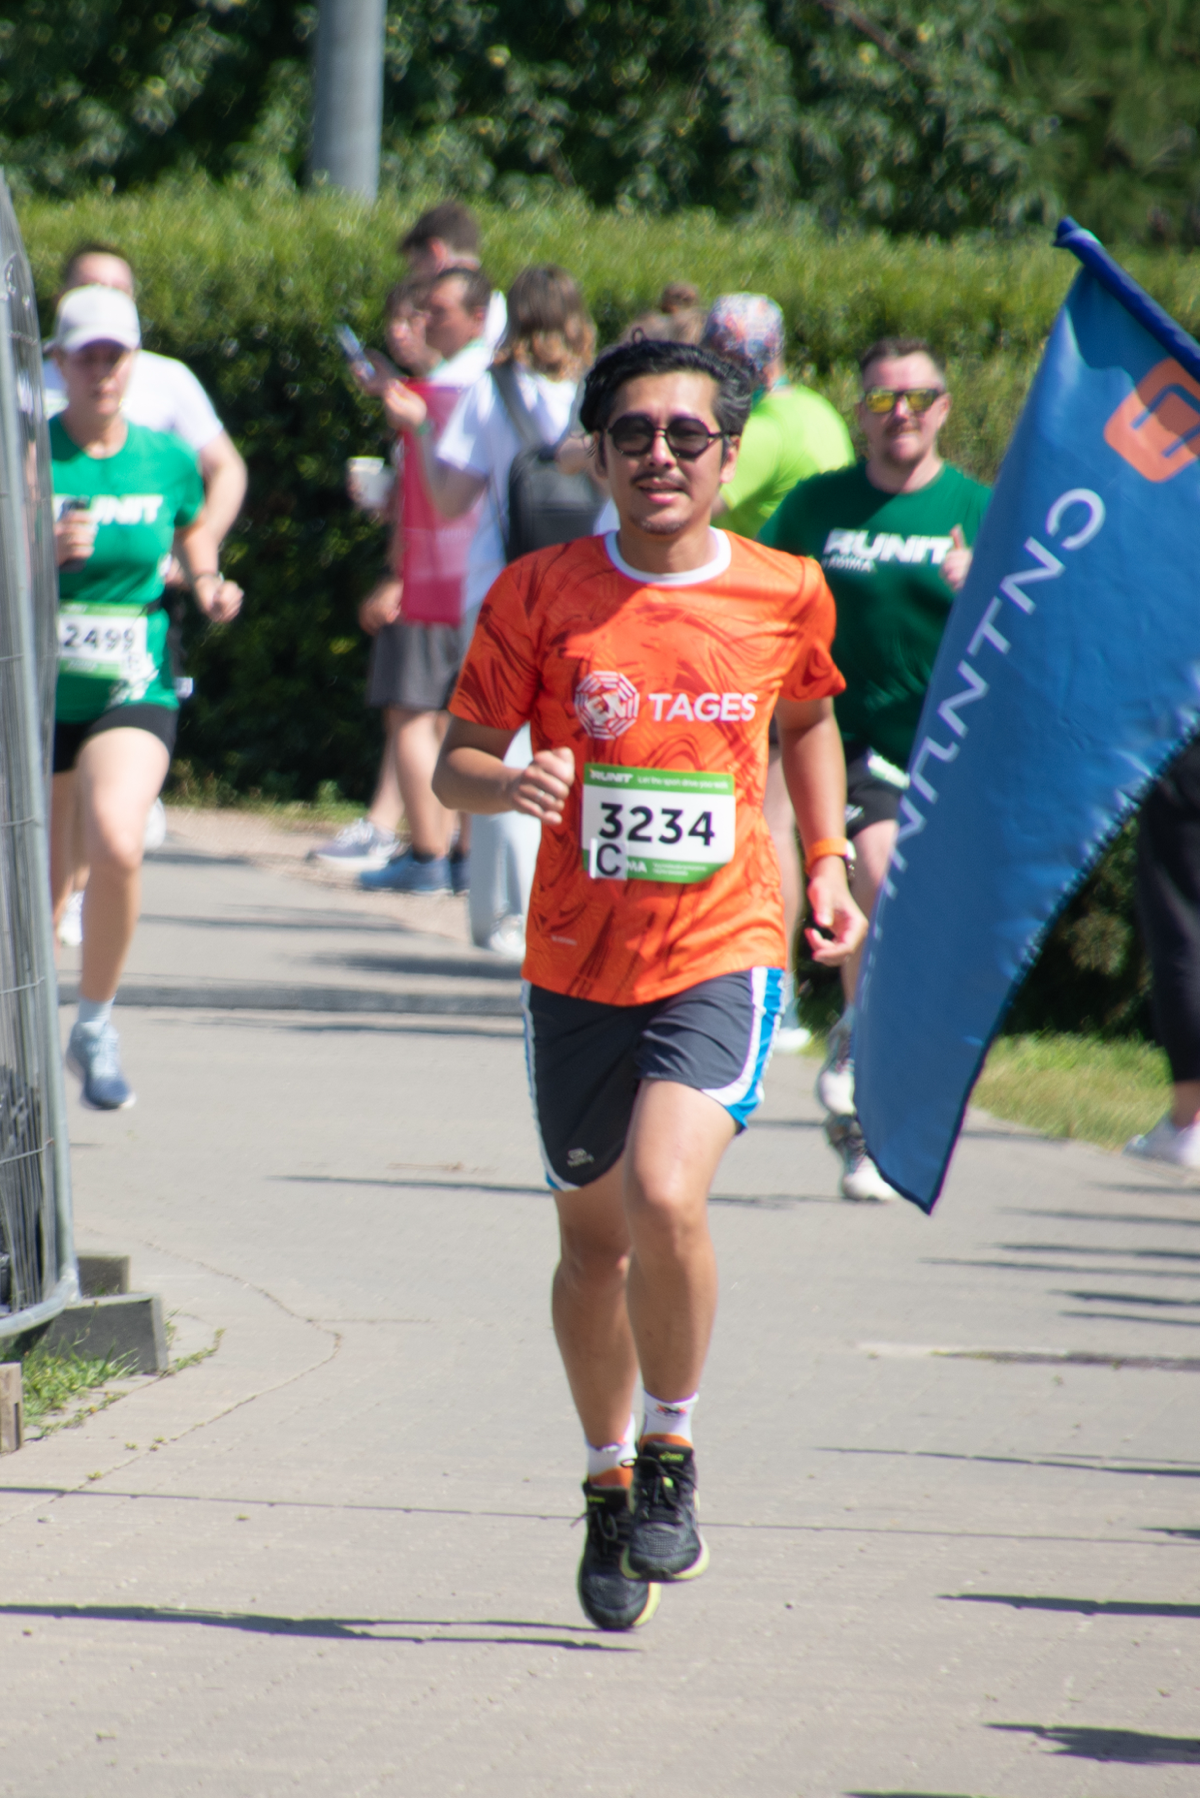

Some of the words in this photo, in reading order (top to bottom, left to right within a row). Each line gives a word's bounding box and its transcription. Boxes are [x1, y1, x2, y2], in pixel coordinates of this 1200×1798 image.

[823, 527, 954, 565] RUNIT
[63, 623, 136, 652] 2499
[648, 692, 758, 722] TAGES
[590, 769, 633, 783] RUNIT
[598, 802, 715, 846] 3234
[596, 843, 622, 876] C
